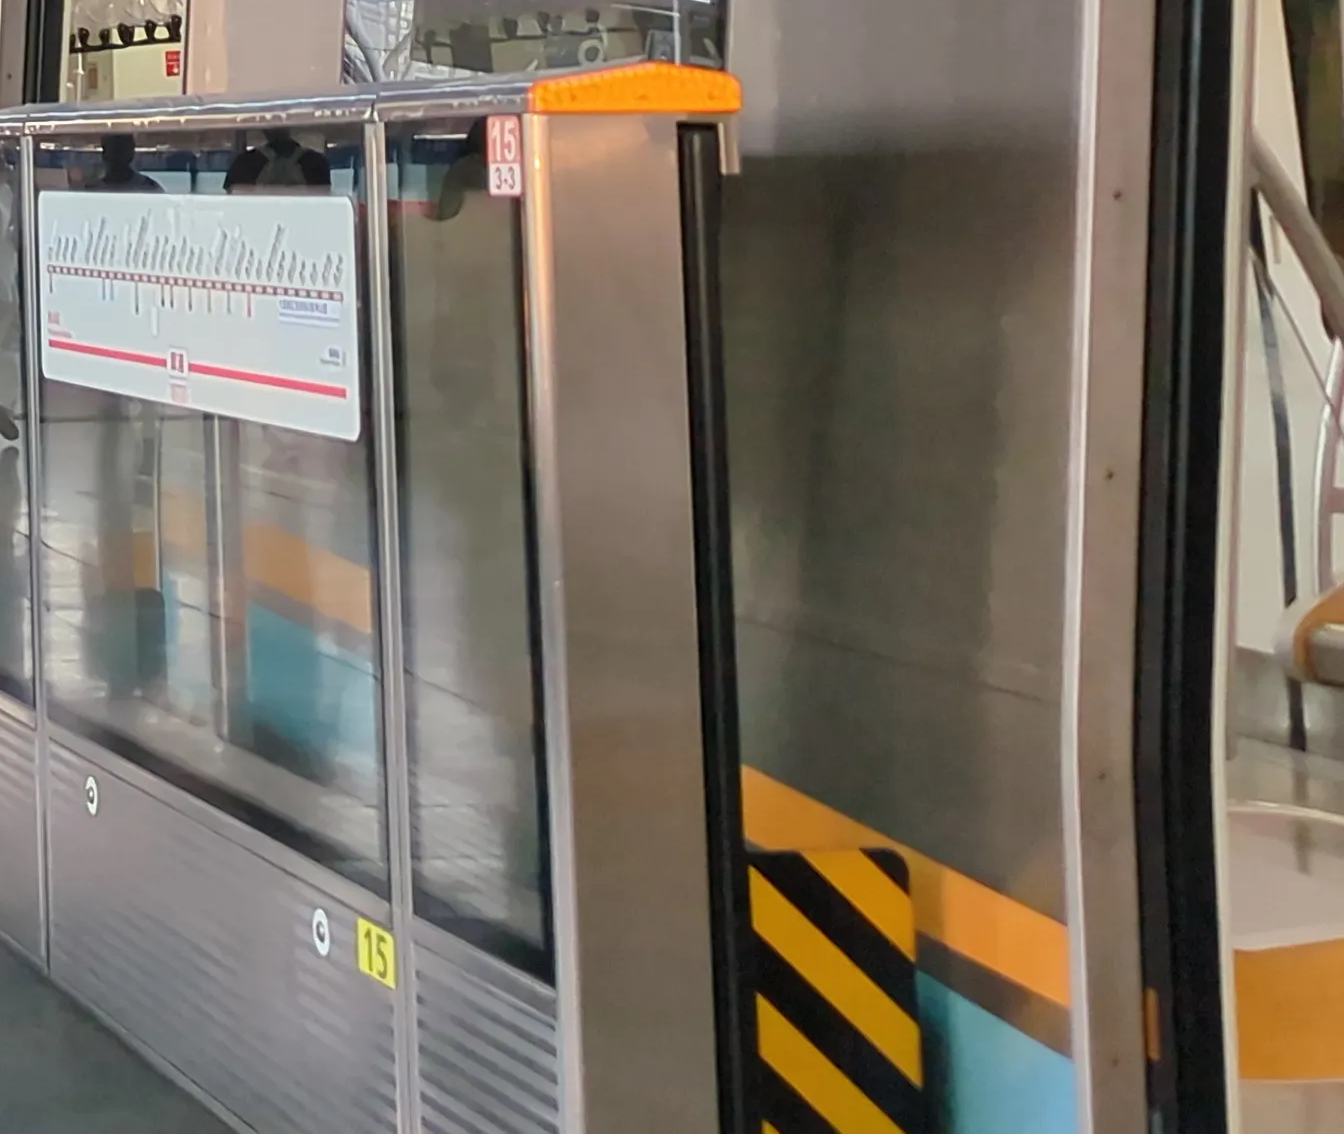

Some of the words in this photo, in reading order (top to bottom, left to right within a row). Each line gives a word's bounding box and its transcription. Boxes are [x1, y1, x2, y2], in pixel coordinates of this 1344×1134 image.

[491, 119, 516, 161] 15
[494, 166, 516, 190] 3-3
[364, 927, 388, 980] 15
